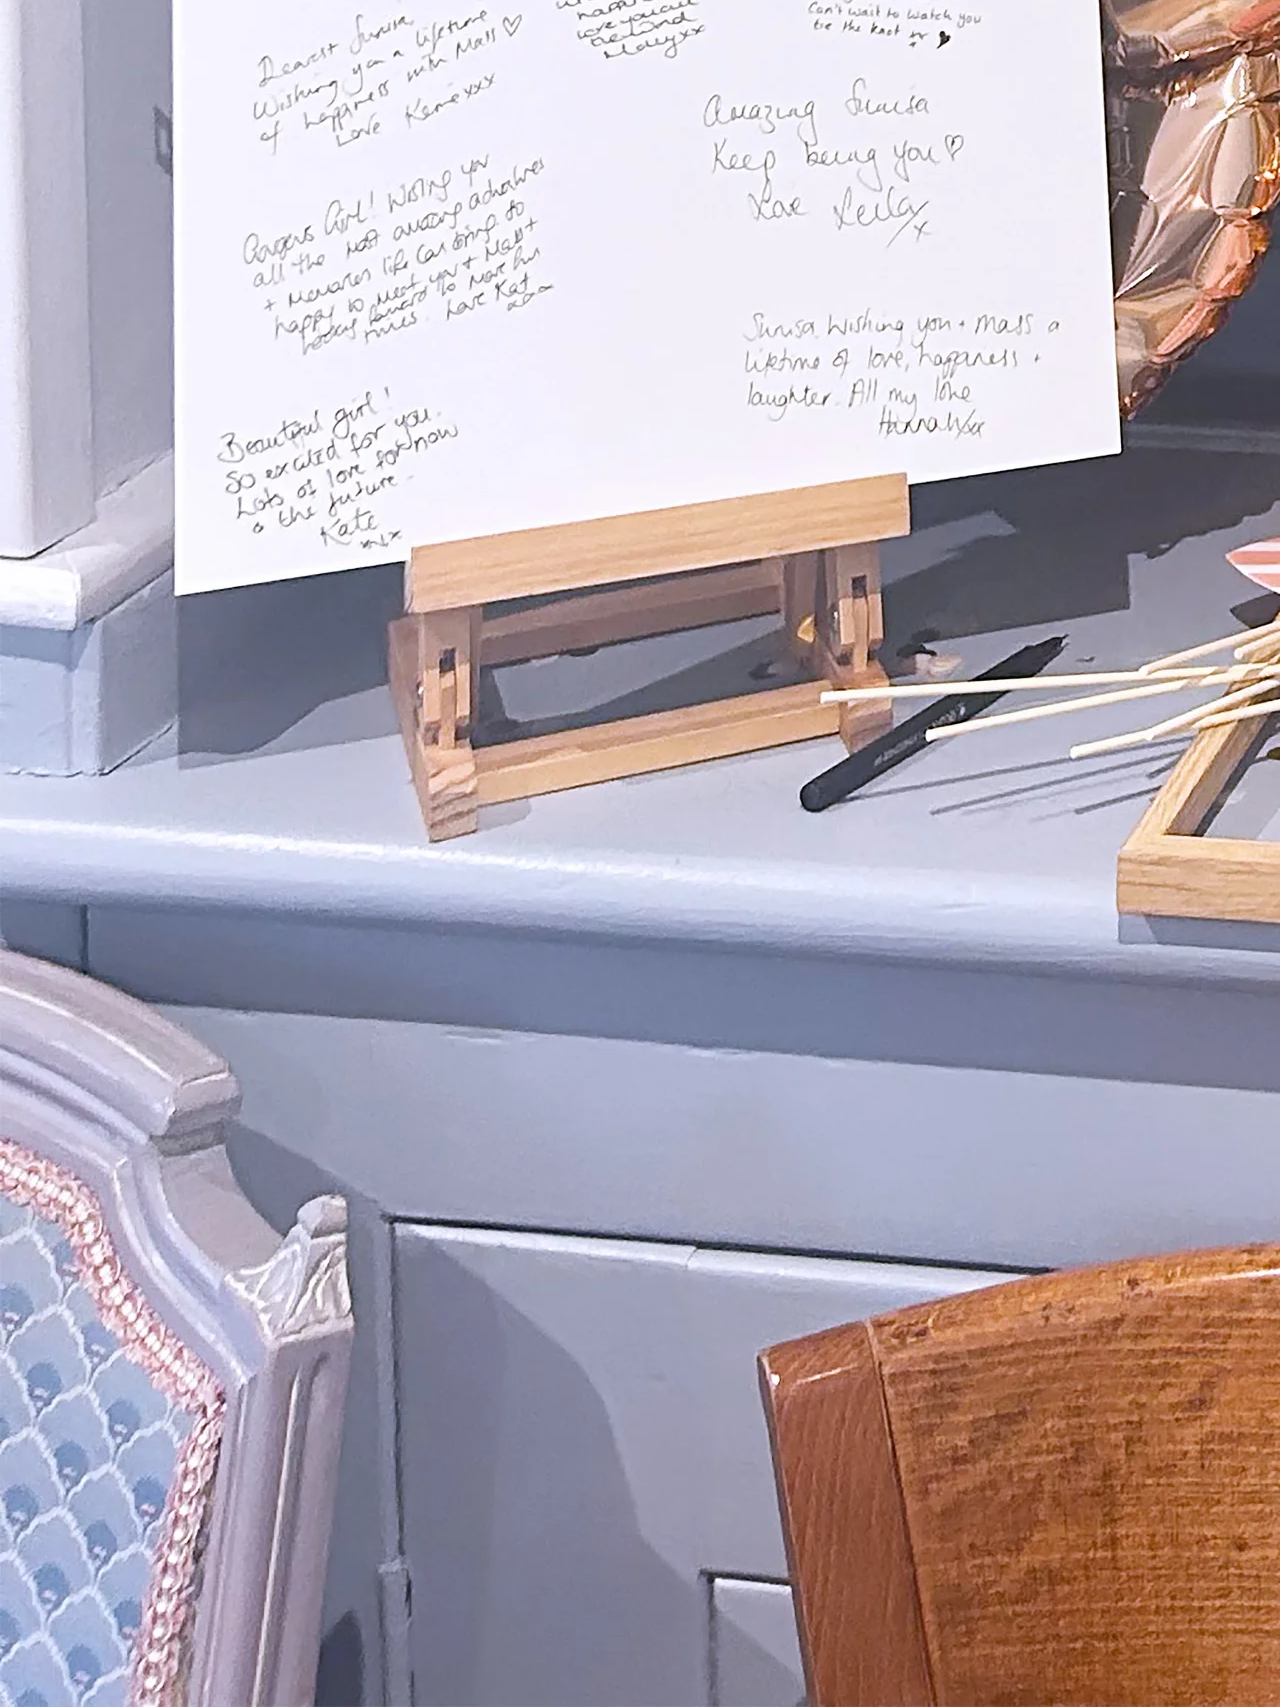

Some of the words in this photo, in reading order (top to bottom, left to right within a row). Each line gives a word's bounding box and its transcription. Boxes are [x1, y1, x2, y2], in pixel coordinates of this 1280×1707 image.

[814, 18, 832, 31] tie
[842, 19, 861, 32] the
[848, 5, 880, 17] wait
[886, 6, 899, 18] to
[957, 13, 982, 28] you
[894, 140, 940, 183] you
[253, 260, 285, 288] all
[291, 252, 326, 274] the
[910, 316, 951, 349] you
[1047, 320, 1060, 333] a
[744, 347, 820, 379] lifetime
[832, 347, 852, 378] of
[849, 378, 879, 408] All
[889, 388, 918, 417] my
[935, 376, 972, 402] love
[351, 423, 386, 459] for
[279, 507, 317, 528] the
